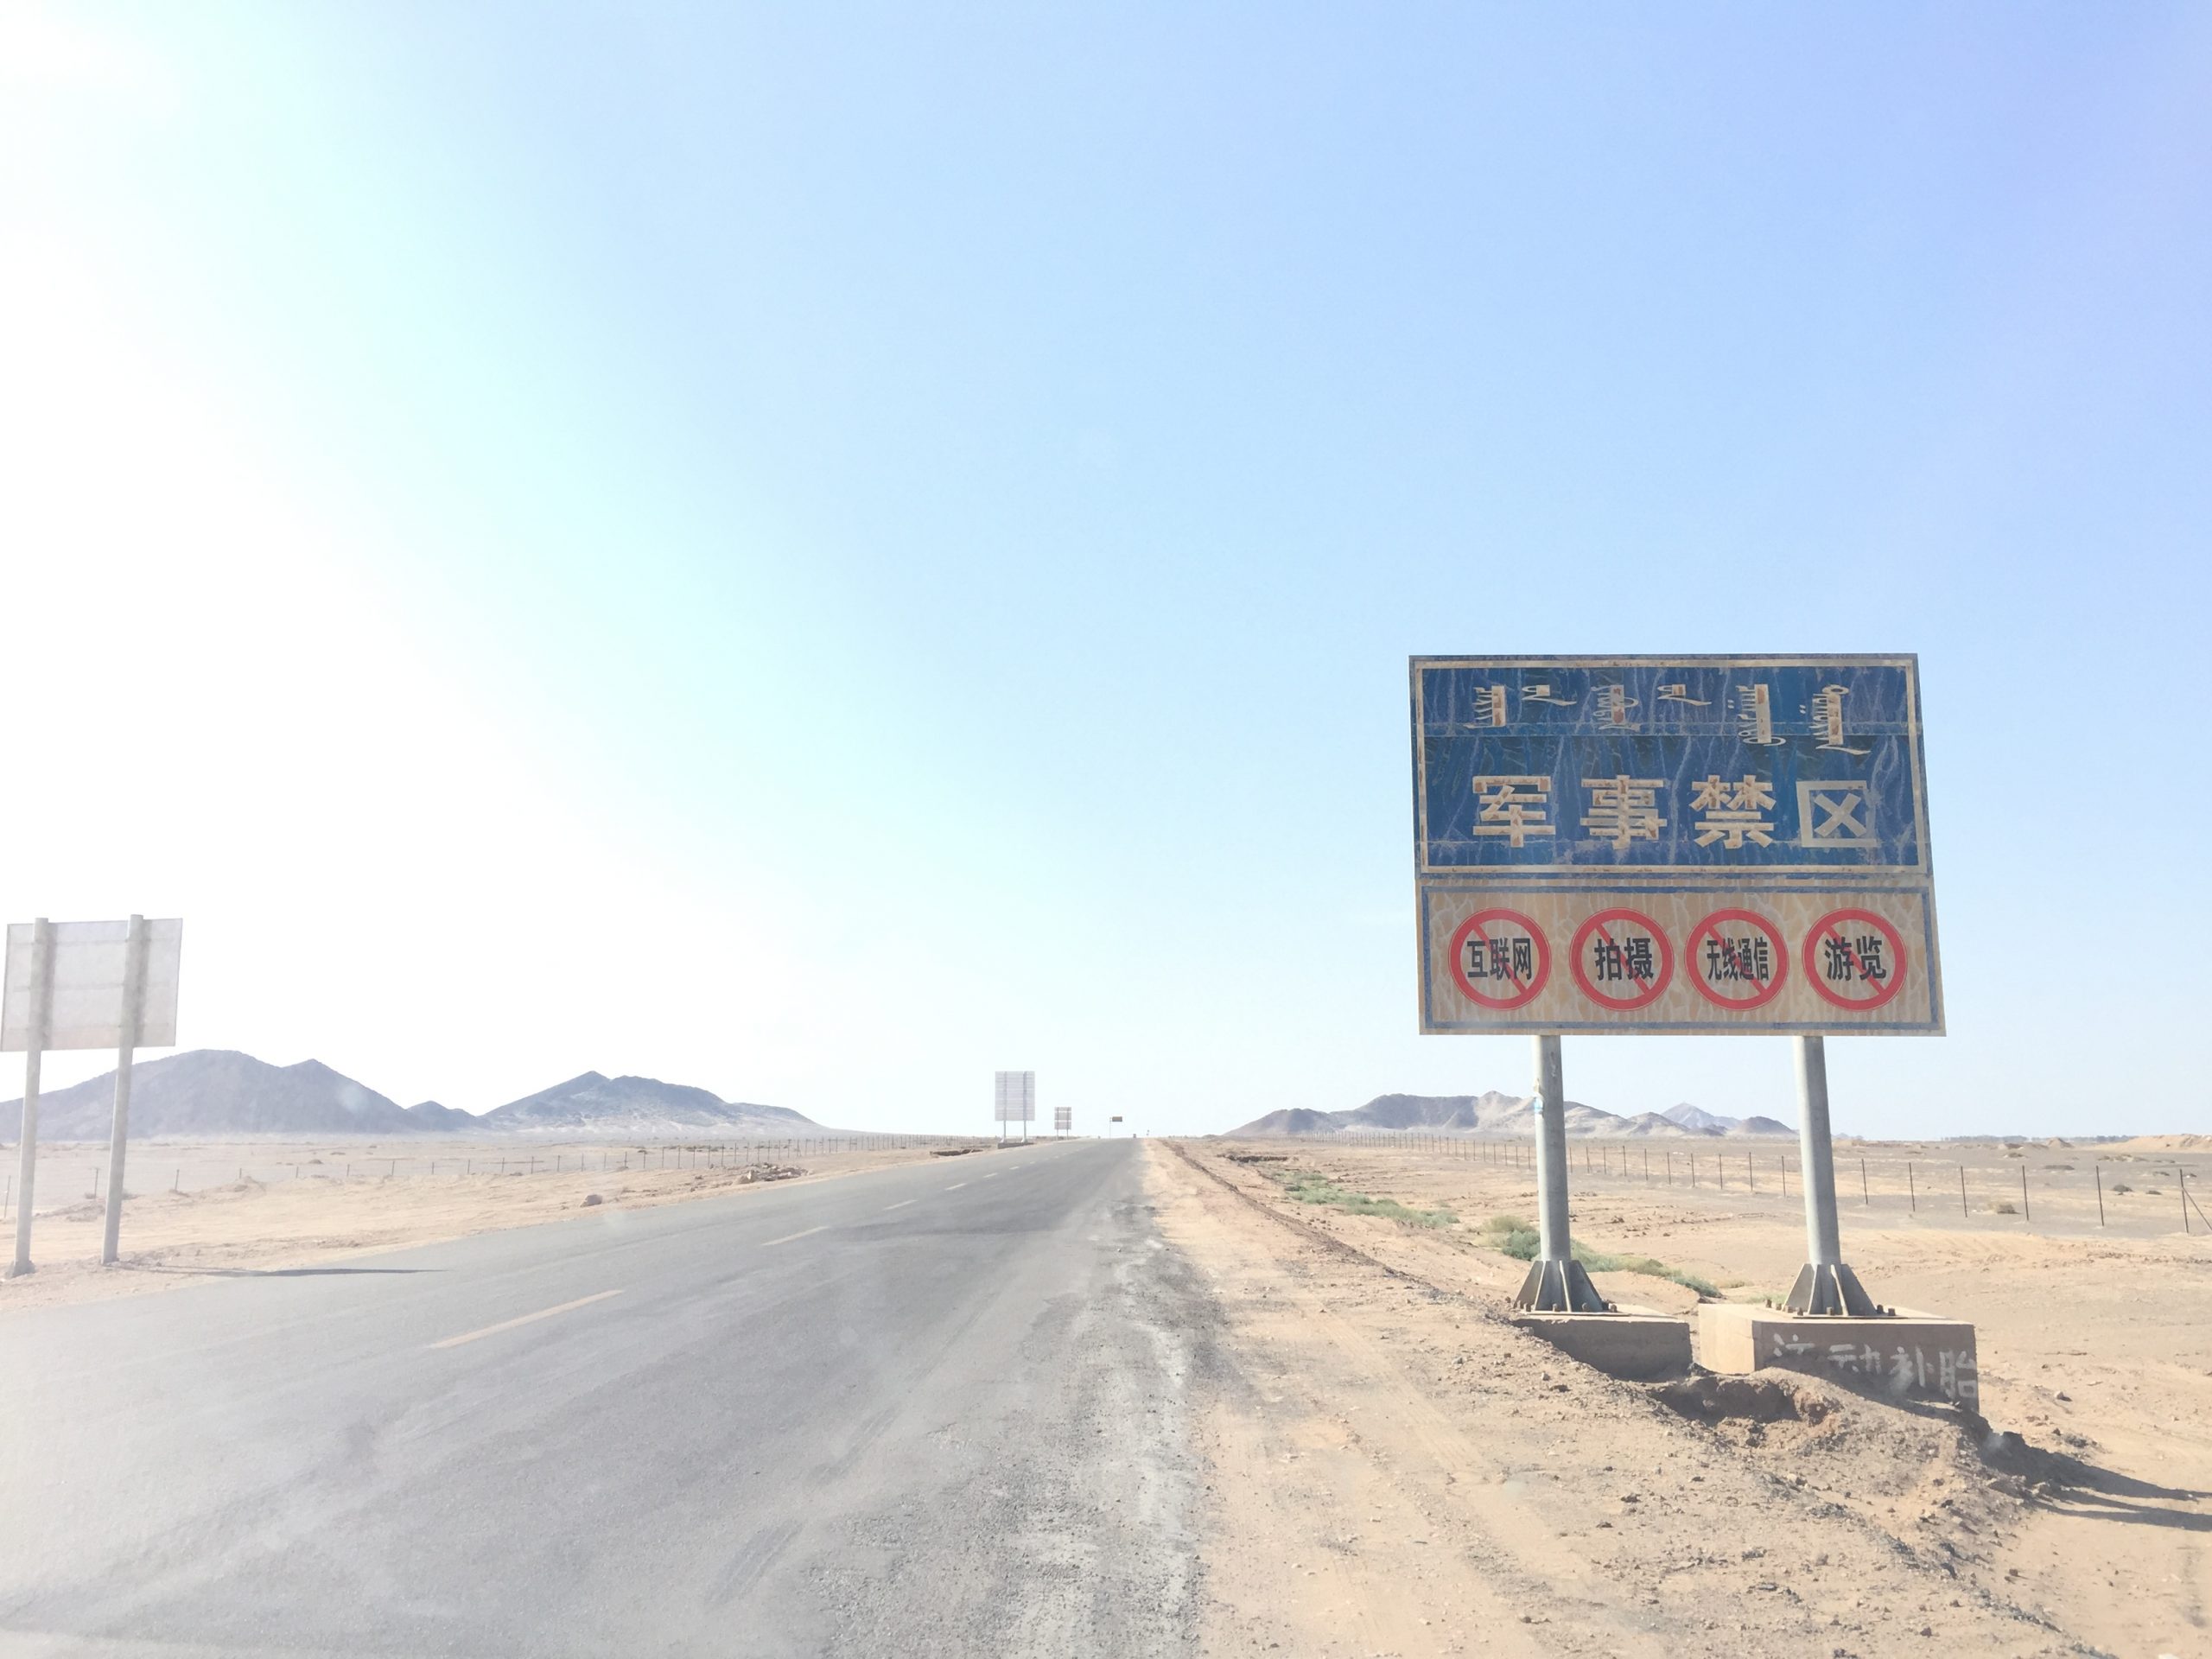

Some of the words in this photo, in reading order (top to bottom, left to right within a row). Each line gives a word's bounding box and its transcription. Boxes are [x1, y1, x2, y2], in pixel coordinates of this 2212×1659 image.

[1471, 774, 1881, 850] 军事禁区
[1466, 937, 1533, 981] 互联网
[1593, 937, 1654, 982] 拍摄
[1706, 936, 1770, 982] 无线通信
[1824, 936, 1886, 982] 游览
